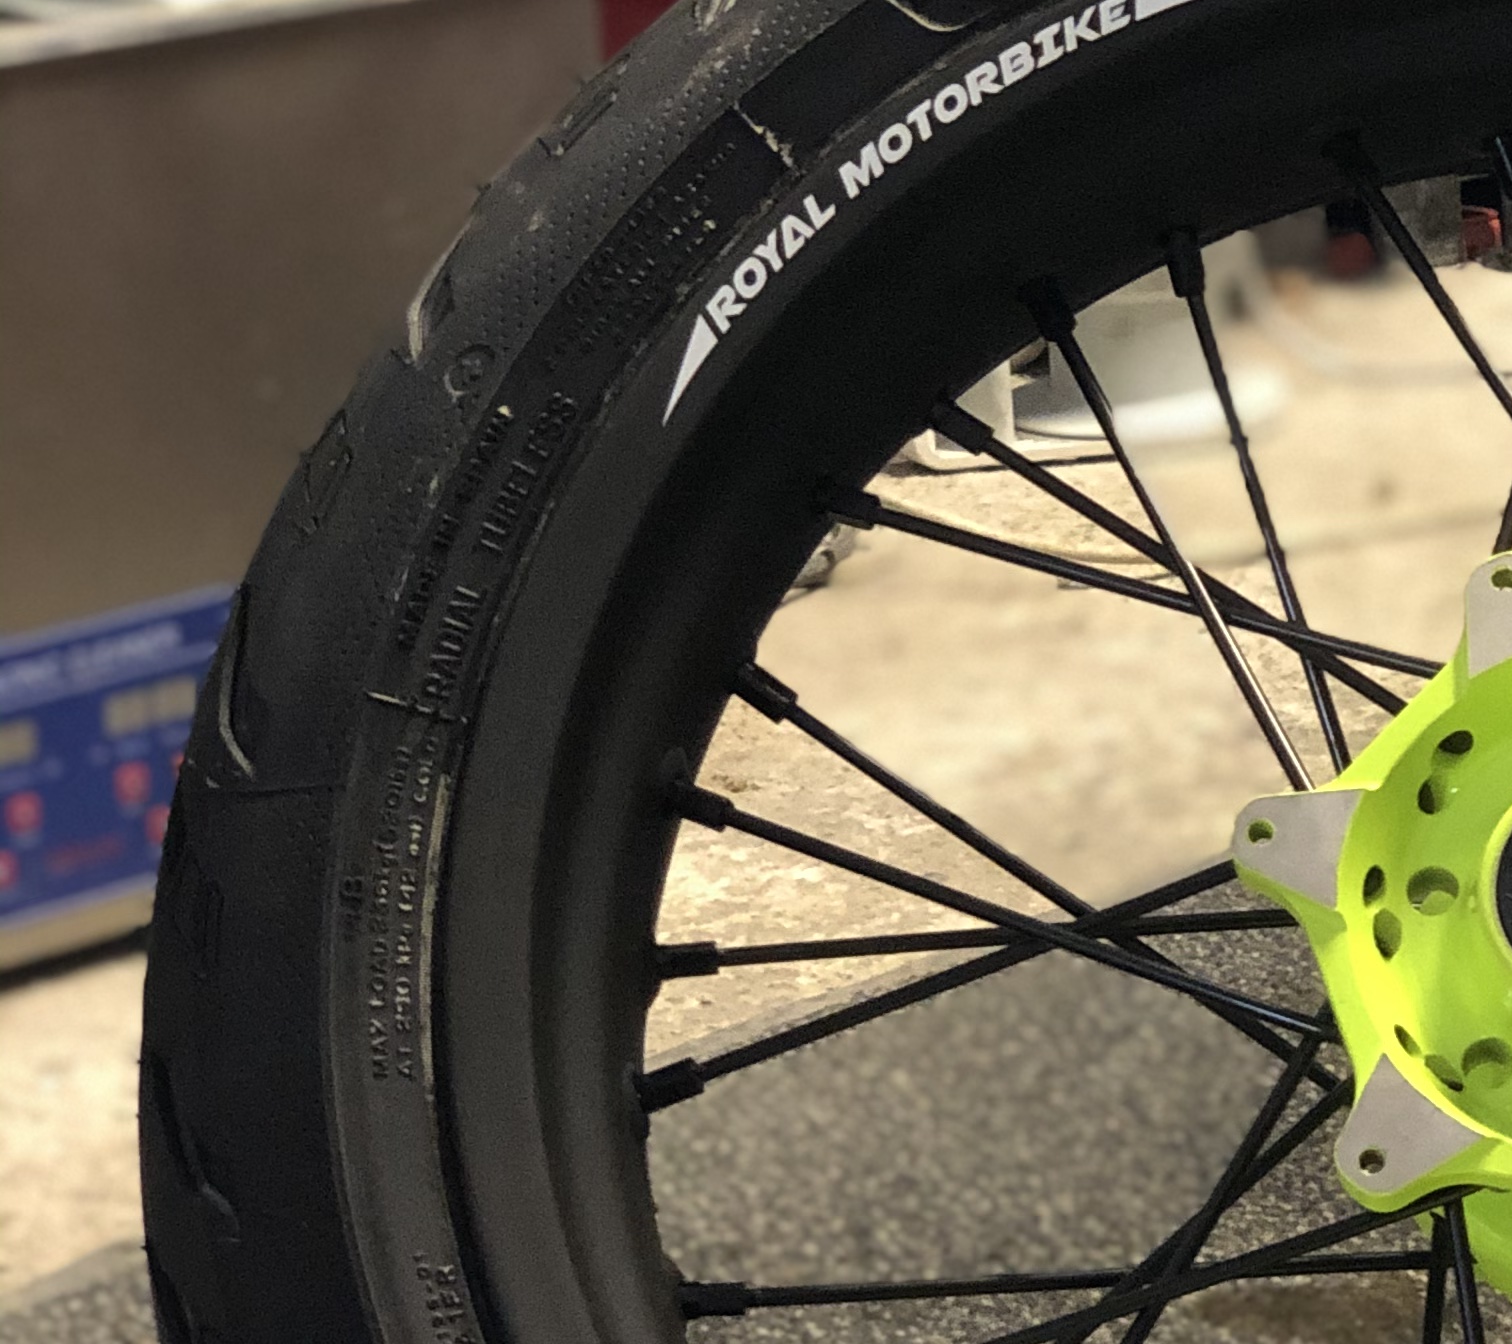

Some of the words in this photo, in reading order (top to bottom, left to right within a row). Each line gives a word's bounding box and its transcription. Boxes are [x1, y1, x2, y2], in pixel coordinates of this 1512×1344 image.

[705, 195, 836, 334] ROYAL
[418, 579, 489, 704] RADIAL
[470, 388, 584, 561] TUBELESS
